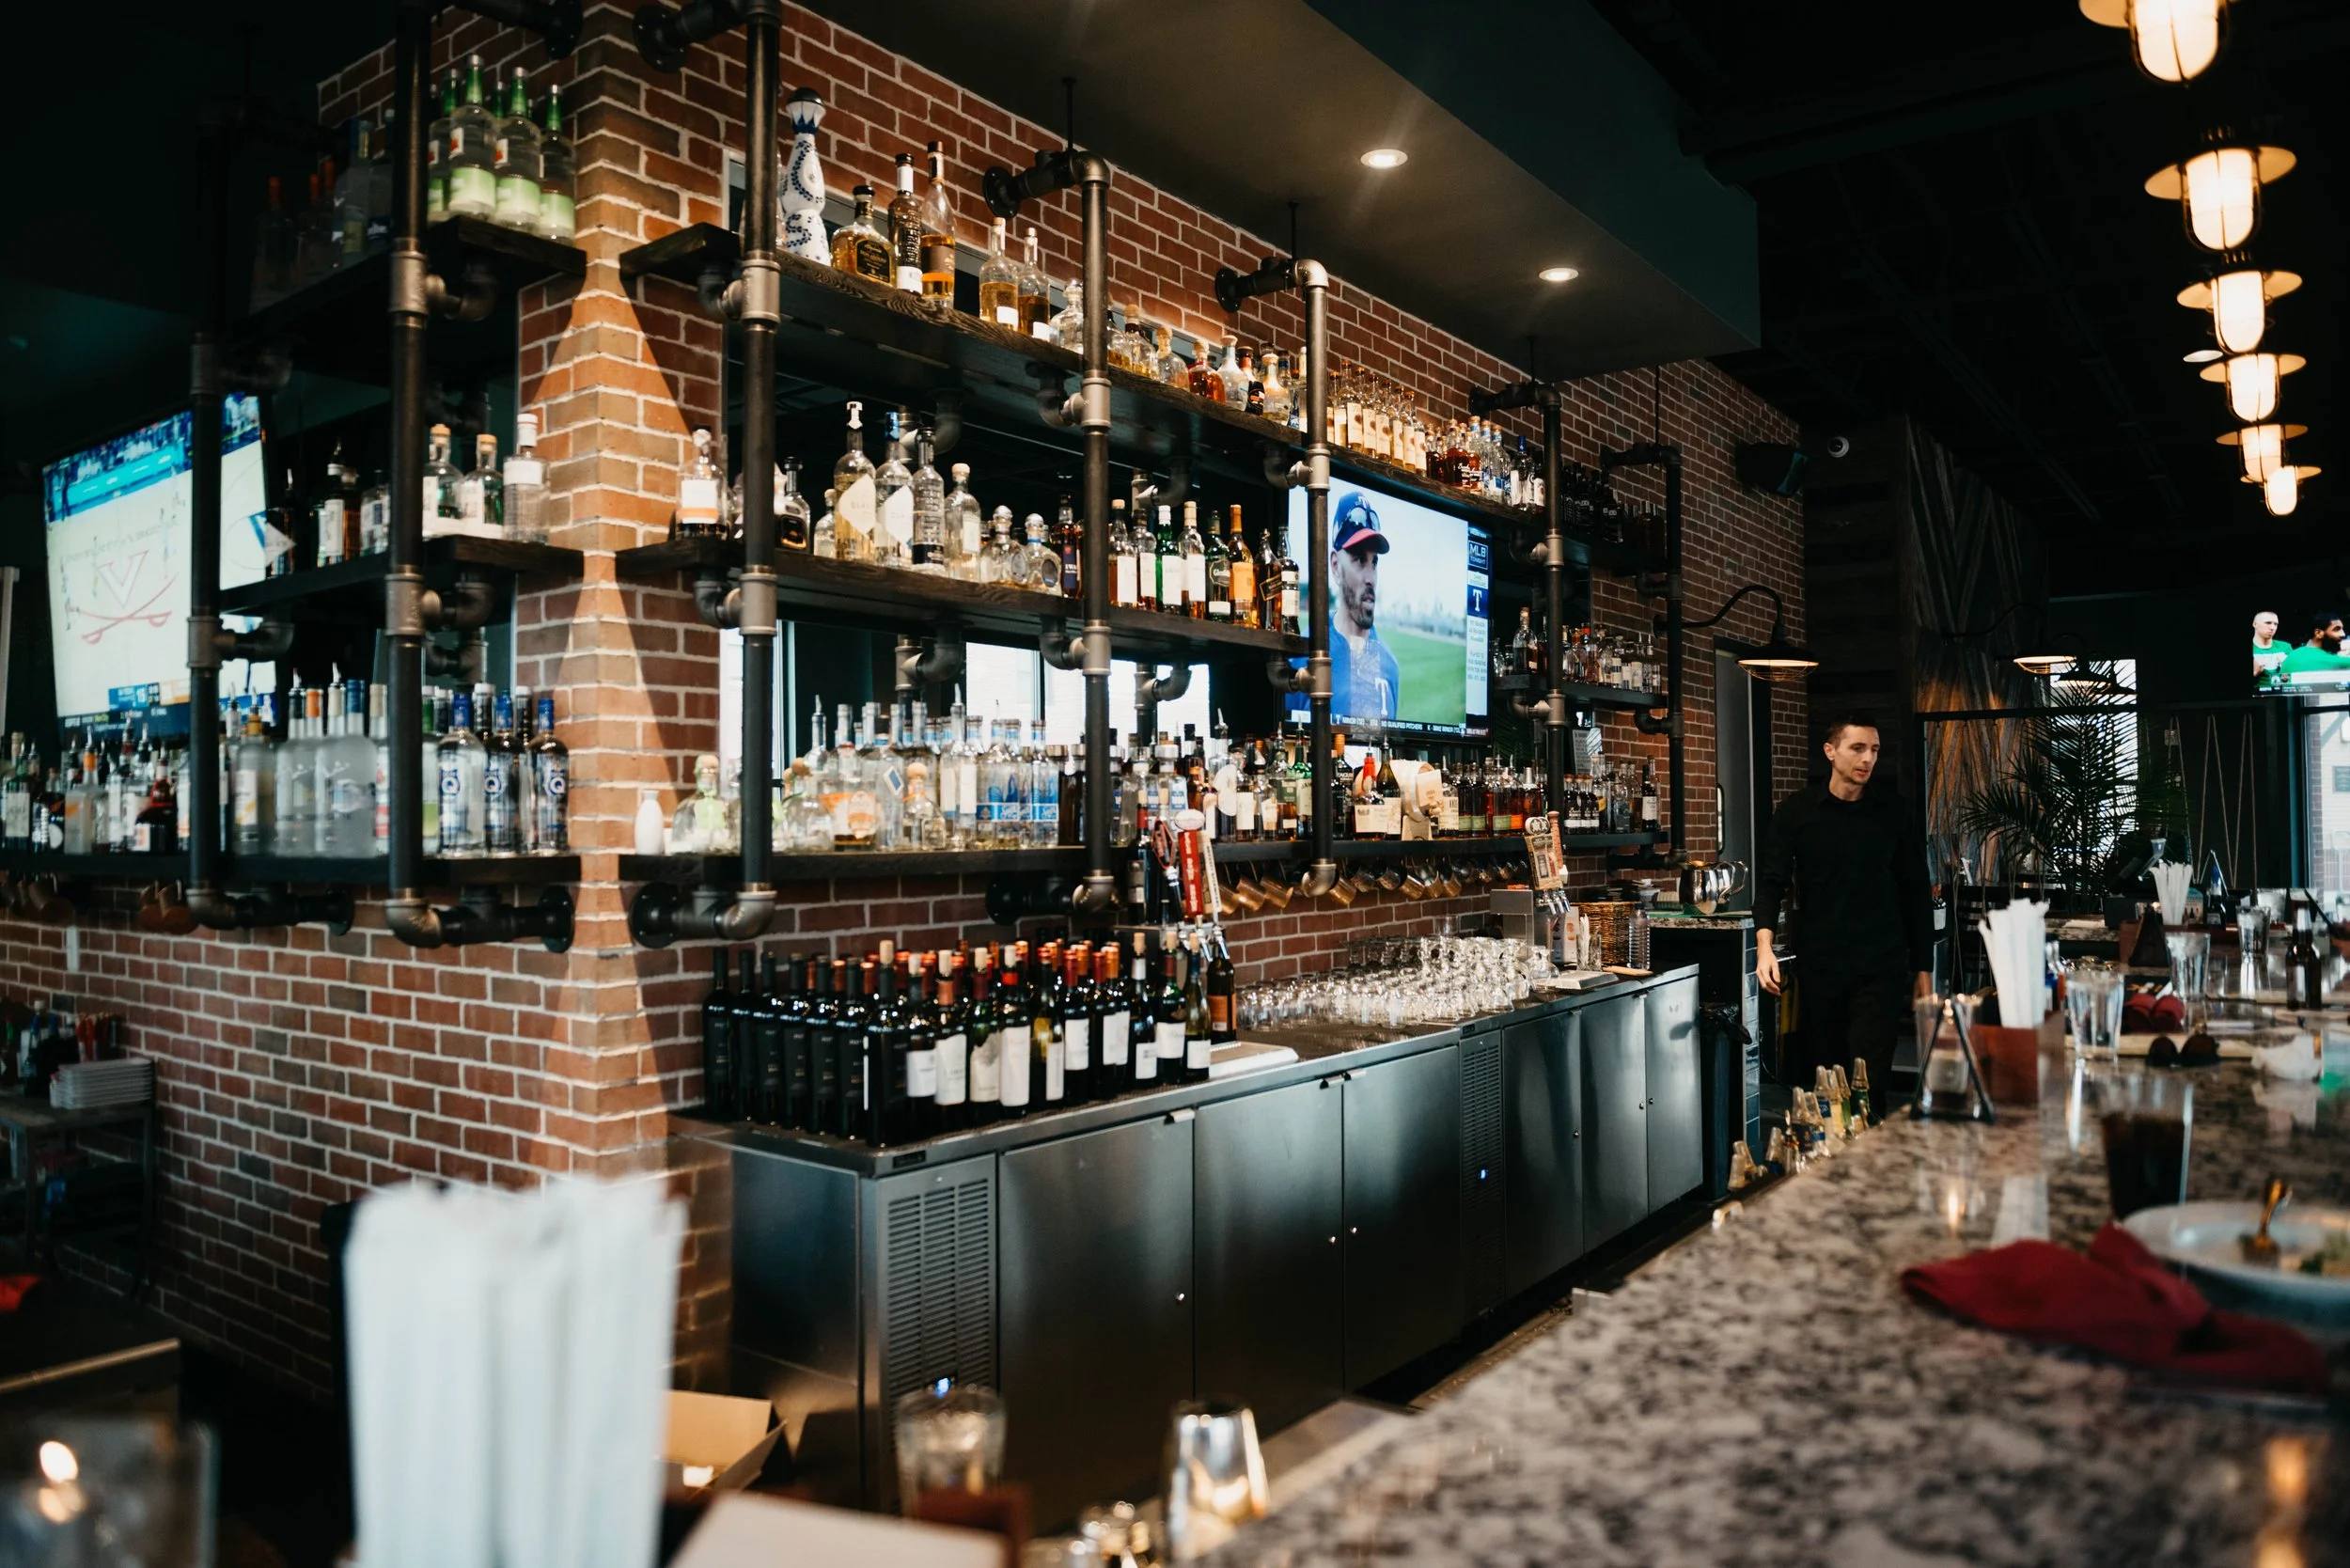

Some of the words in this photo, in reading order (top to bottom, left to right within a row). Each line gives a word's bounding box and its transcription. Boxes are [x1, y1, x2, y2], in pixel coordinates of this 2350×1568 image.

[1469, 543, 1486, 558] MLB
[95, 550, 149, 609] V
[1472, 588, 1482, 612] T
[1375, 678, 1388, 716] T
[484, 776, 502, 794] Q
[549, 776, 566, 794] Q
